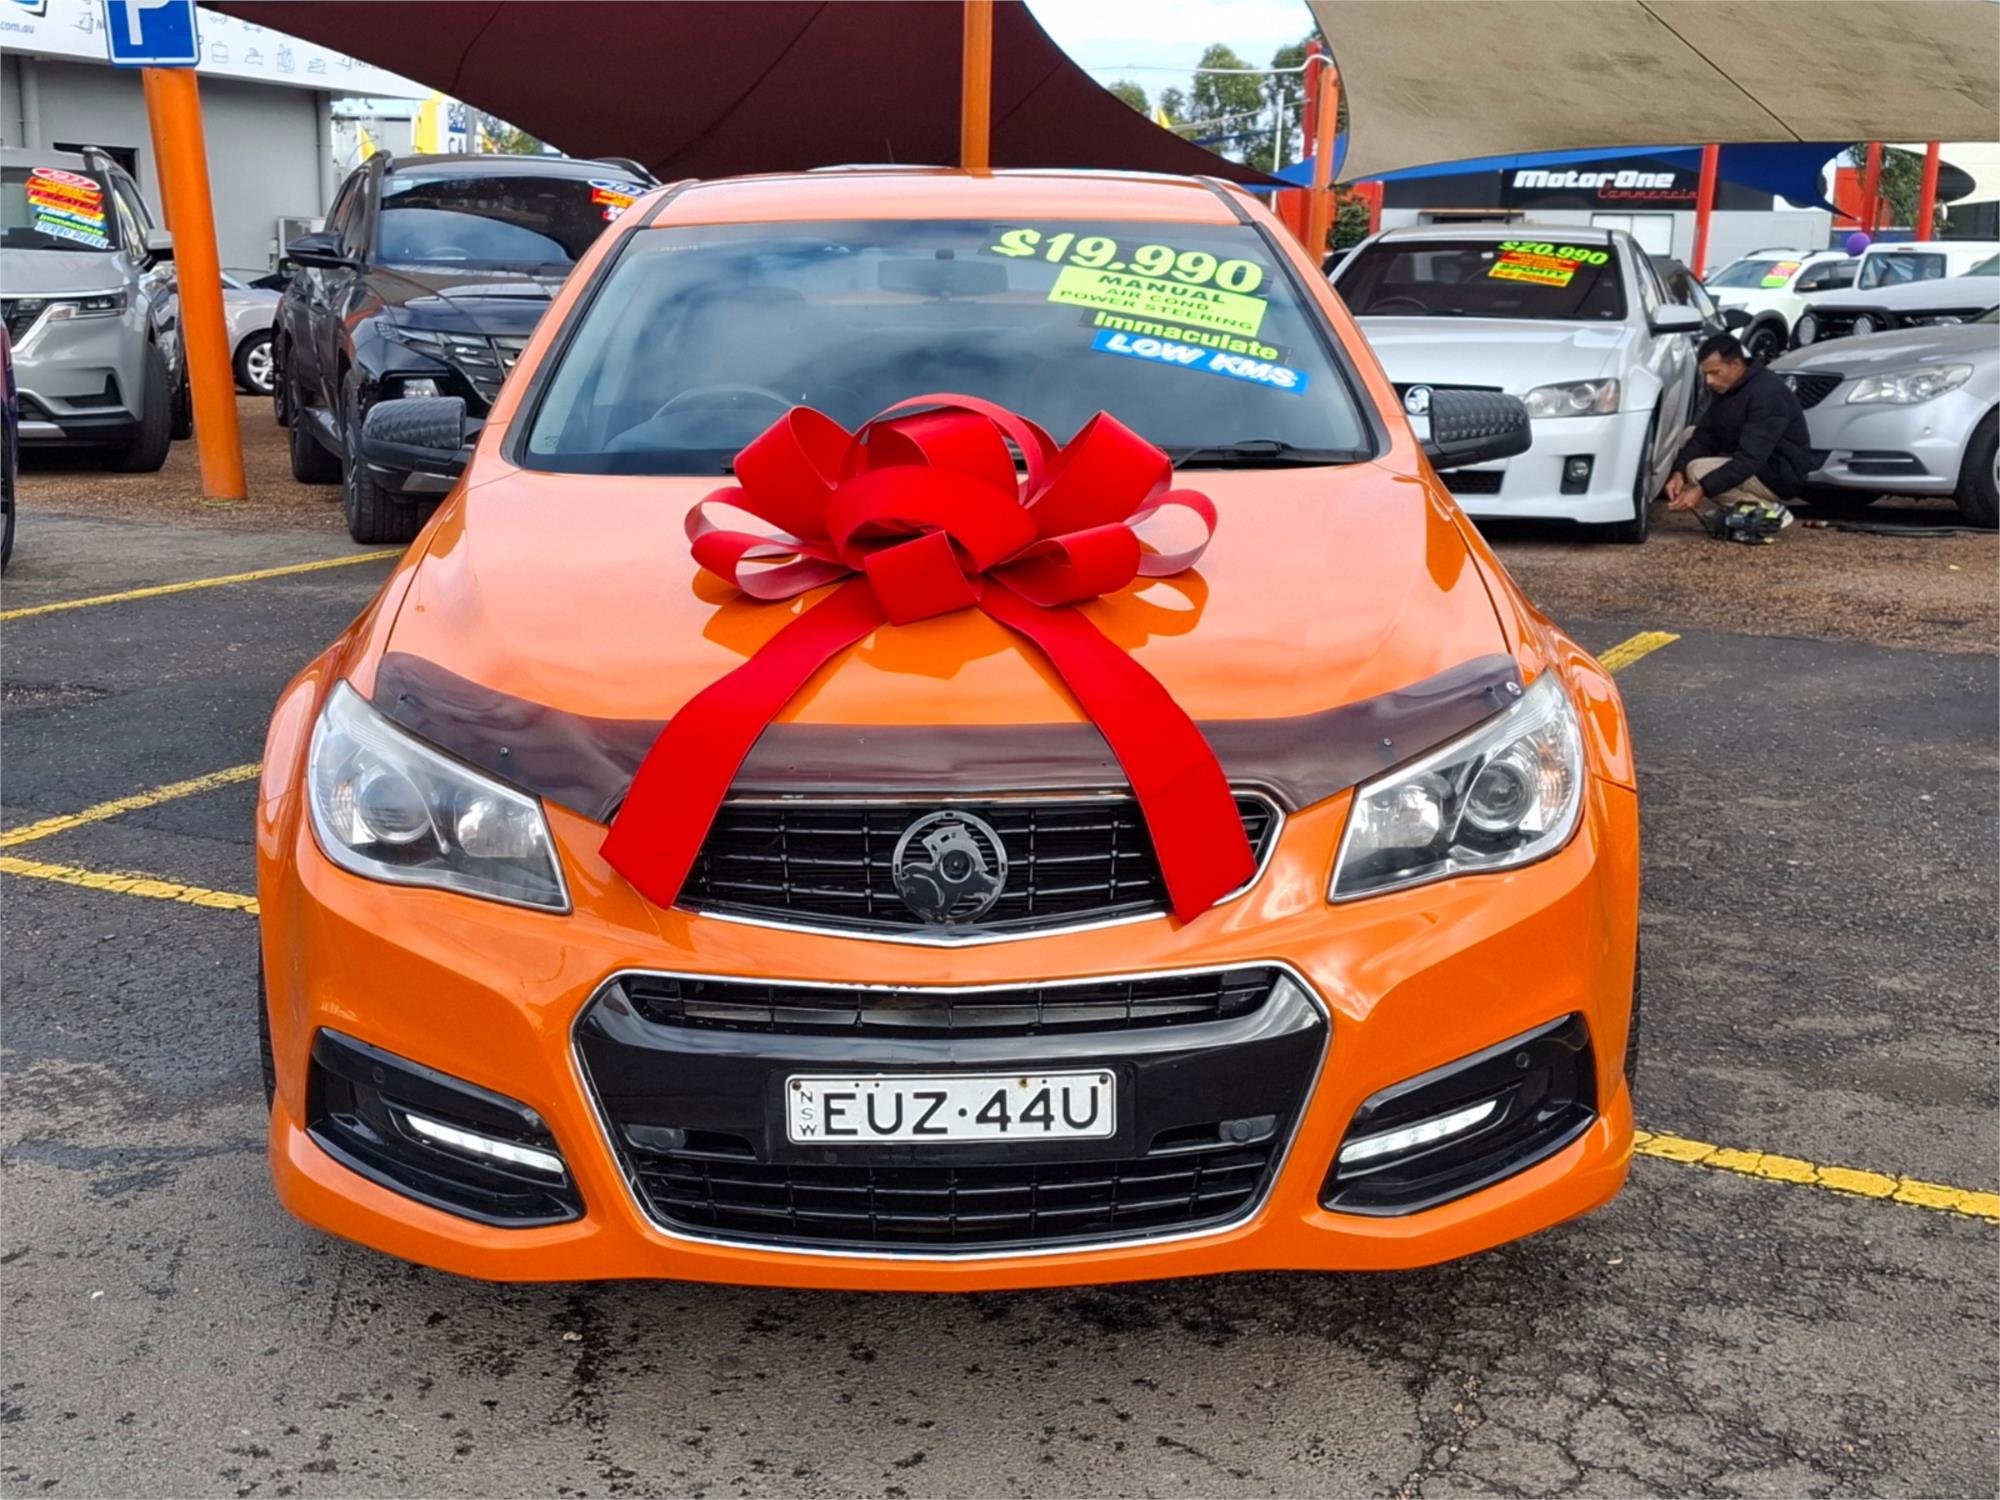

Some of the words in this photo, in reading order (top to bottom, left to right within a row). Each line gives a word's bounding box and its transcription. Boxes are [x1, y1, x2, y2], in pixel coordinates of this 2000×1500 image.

[1513, 170, 1676, 188] MotorOne
[1597, 182, 1699, 199] Commercia
[38, 221, 71, 235] TURBO
[73, 231, 108, 248] DIESEL
[1499, 263, 1567, 277] SPORTY
[1098, 275, 1225, 304] MANUAL
[1106, 288, 1142, 299] AIR
[1150, 295, 1214, 312] COND.
[1059, 290, 1136, 308] POWER
[1144, 303, 1253, 330] STEERING
[1094, 312, 1279, 361] Immaculate
[1106, 334, 1205, 364] LOW
[1209, 352, 1299, 388] KMS
